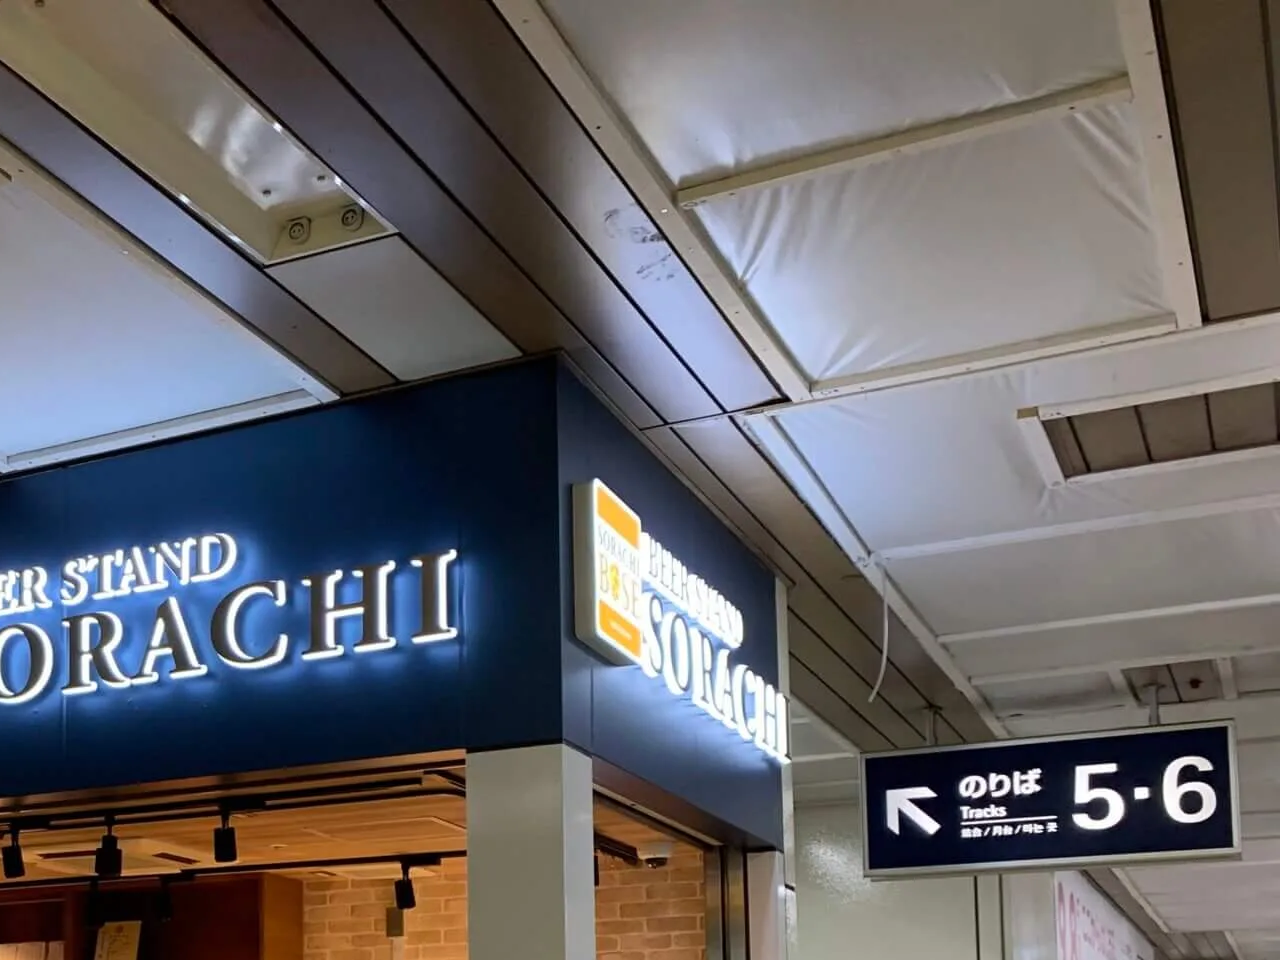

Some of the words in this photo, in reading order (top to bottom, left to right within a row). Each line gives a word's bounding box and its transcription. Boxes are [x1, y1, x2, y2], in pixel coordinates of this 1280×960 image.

[60, 532, 238, 606] STAND
[640, 591, 792, 764] SORACHI
[959, 767, 1043, 799] のりば
[959, 804, 1008, 819] Tracks
